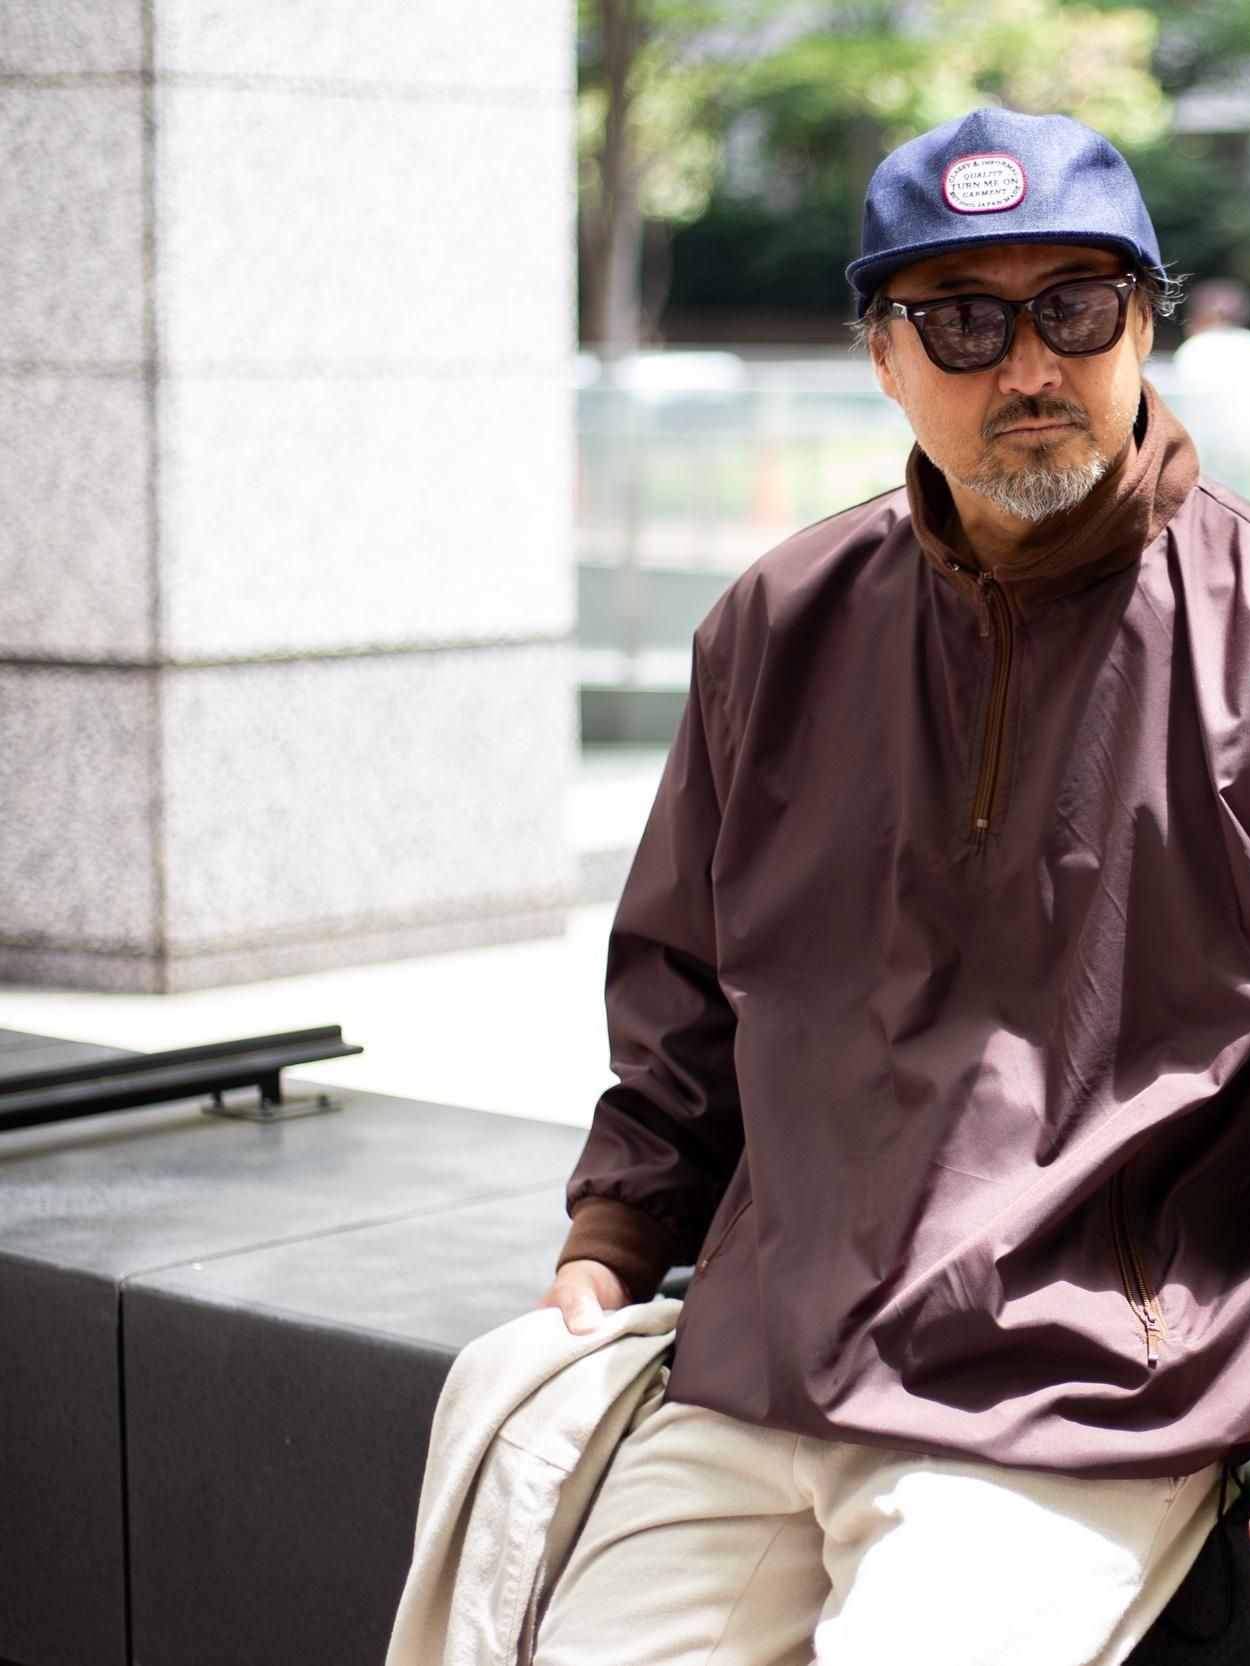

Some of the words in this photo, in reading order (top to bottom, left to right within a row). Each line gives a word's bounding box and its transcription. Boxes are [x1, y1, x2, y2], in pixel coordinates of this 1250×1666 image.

[963, 170, 1003, 180] QUALITY
[953, 181, 980, 191] TURN
[984, 180, 998, 188] ME
[962, 188, 1007, 198] GARMENT
